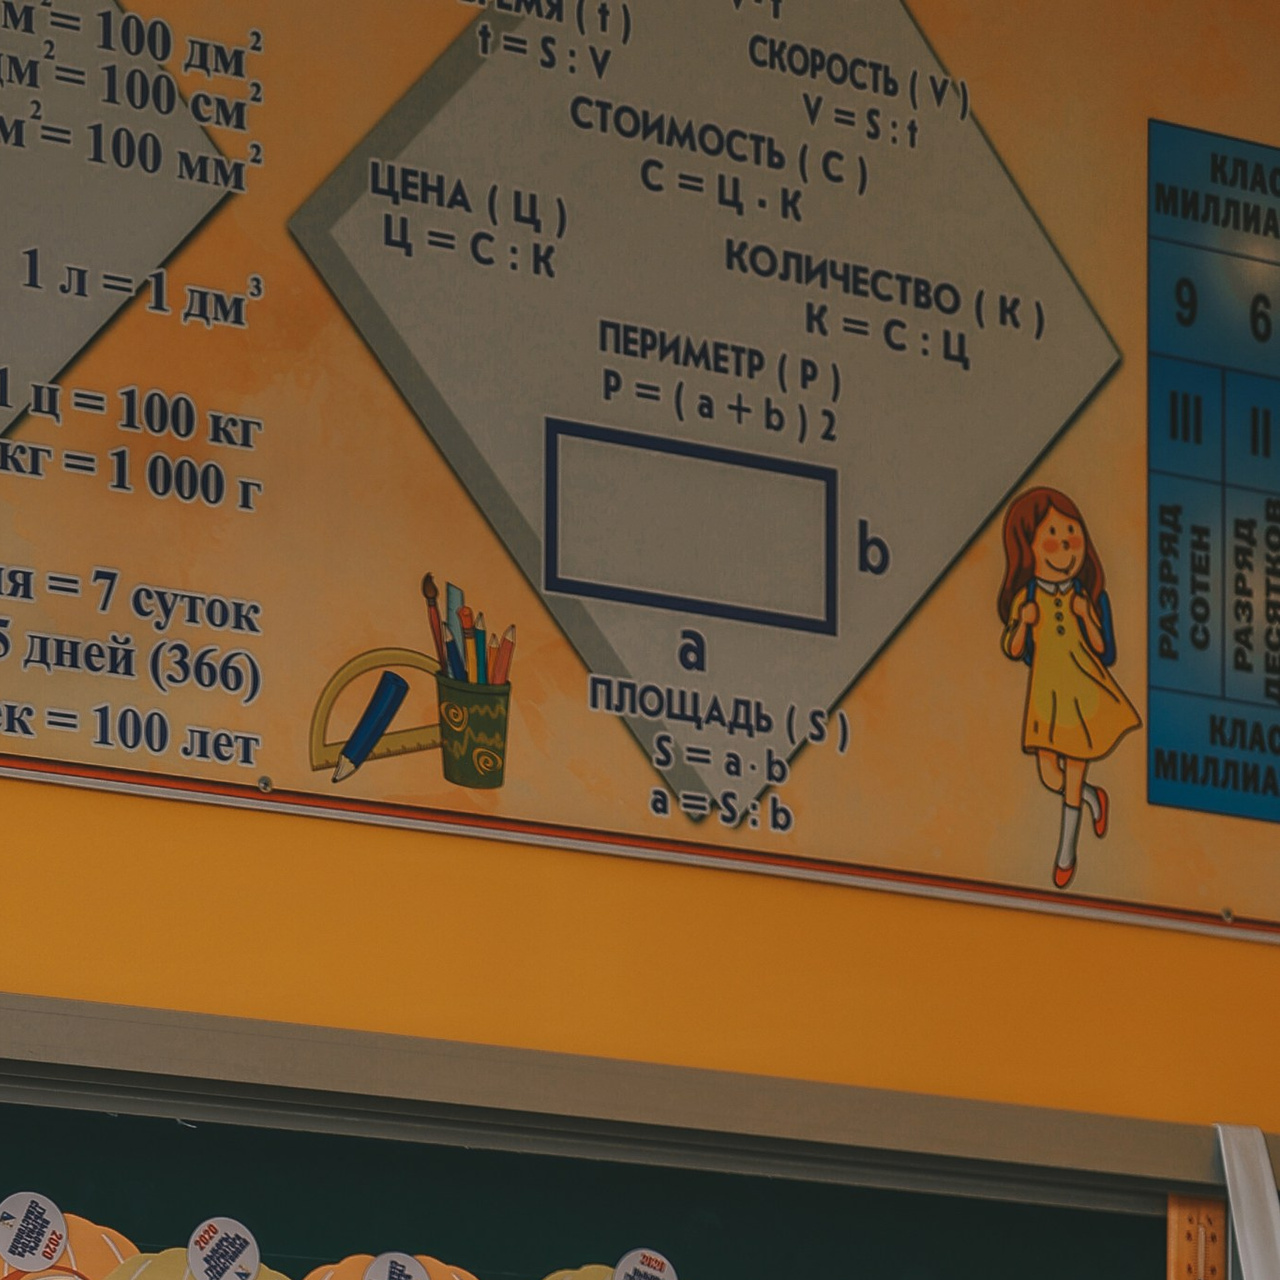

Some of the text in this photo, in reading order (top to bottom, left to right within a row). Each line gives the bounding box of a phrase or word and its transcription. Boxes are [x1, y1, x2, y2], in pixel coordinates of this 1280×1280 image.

[97, 10, 172, 62] 100
[748, 34, 899, 97] СКОРОСТЬ
[101, 64, 176, 115] 100
[87, 123, 162, 174] 100
[570, 96, 786, 170] СТОИМОСТЬ
[371, 162, 472, 213] ЦЕНА
[23, 248, 42, 289] 1
[59, 266, 88, 298] л
[148, 271, 168, 312] 1
[725, 238, 961, 315] КОЛИЧЕСТВО
[1175, 277, 1198, 328] 9
[1249, 292, 1273, 344] 6
[599, 319, 765, 380] ПЕРИМЕТР
[31, 384, 60, 422] ц
[120, 388, 195, 438] 100
[209, 414, 262, 448] кг
[239, 480, 262, 510] г
[93, 570, 118, 611] 7
[132, 587, 260, 633] суток
[1158, 504, 1183, 662] РАЗРЯД
[1189, 525, 1211, 651] СОТЕН
[1233, 517, 1258, 675] РАЗРЯД
[23, 634, 135, 677] дней
[150, 641, 260, 703] (366)
[94, 705, 168, 753] 100
[182, 729, 259, 765] лет
[590, 677, 773, 738] ПЛОЩАДЬ
